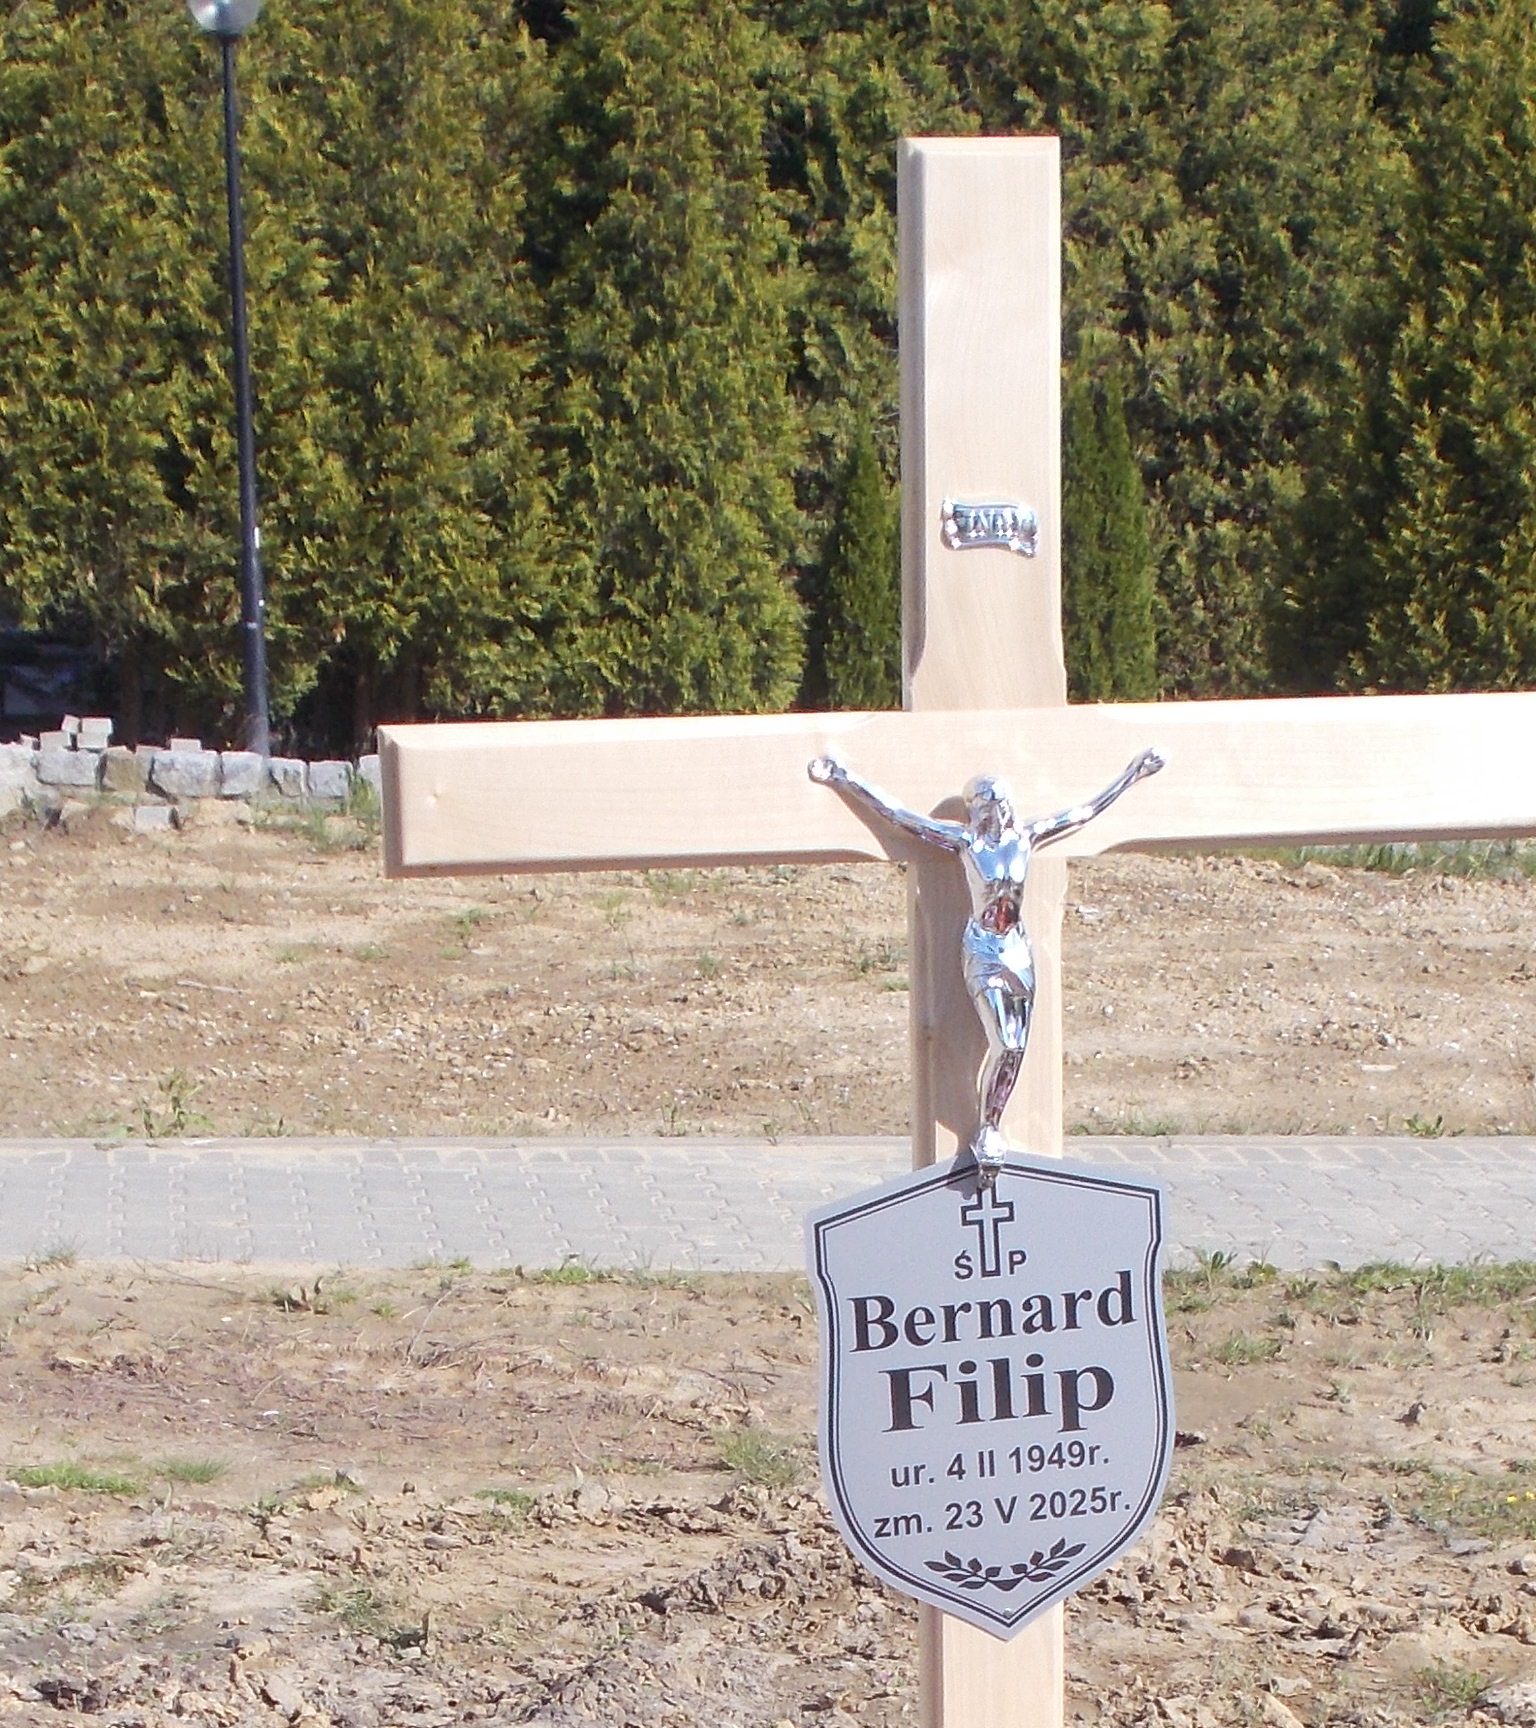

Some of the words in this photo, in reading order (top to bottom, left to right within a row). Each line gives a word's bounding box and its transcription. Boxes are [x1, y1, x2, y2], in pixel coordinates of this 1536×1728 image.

[954, 1249, 974, 1280] Ś
[1008, 1249, 1028, 1276] P
[847, 1269, 1138, 1353] Bernard
[878, 1353, 1115, 1433] Filip
[890, 1463, 935, 1488] ur.
[946, 1453, 967, 1481] 4
[978, 1449, 996, 1478] II
[1008, 1440, 1110, 1475] 1949r.
[873, 1512, 934, 1539] zm.
[944, 1500, 984, 1531] 23
[994, 1495, 1018, 1524] V
[1029, 1486, 1131, 1522] 2025r.
